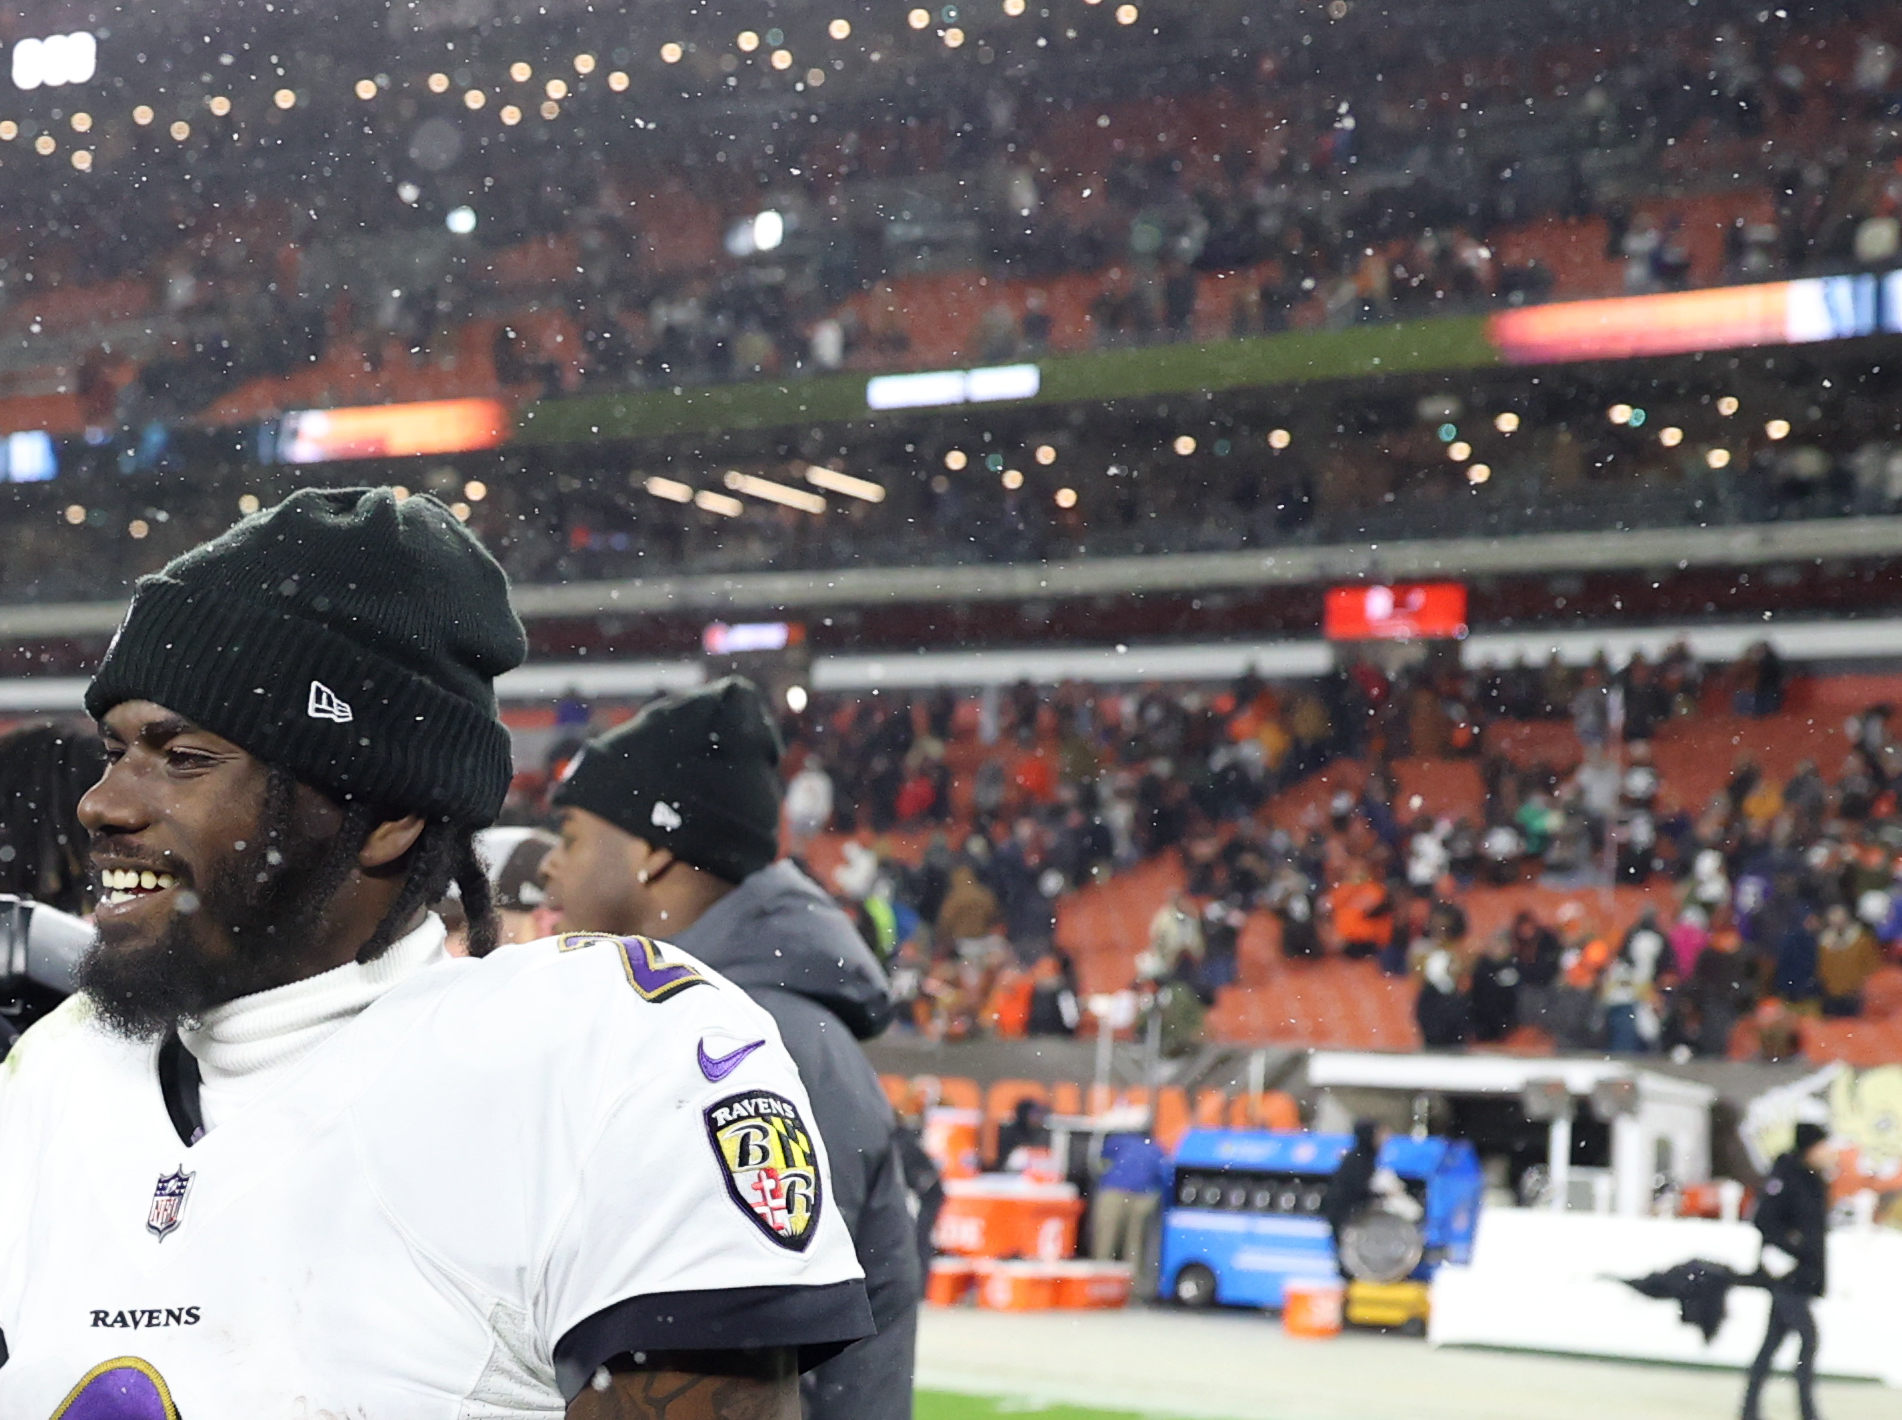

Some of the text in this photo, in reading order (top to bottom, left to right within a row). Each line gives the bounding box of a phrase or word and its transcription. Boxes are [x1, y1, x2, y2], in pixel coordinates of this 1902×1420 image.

[557, 929, 720, 1004] 2
[711, 1098, 795, 1127] RAVENS
[89, 1305, 201, 1331] RAVENS
